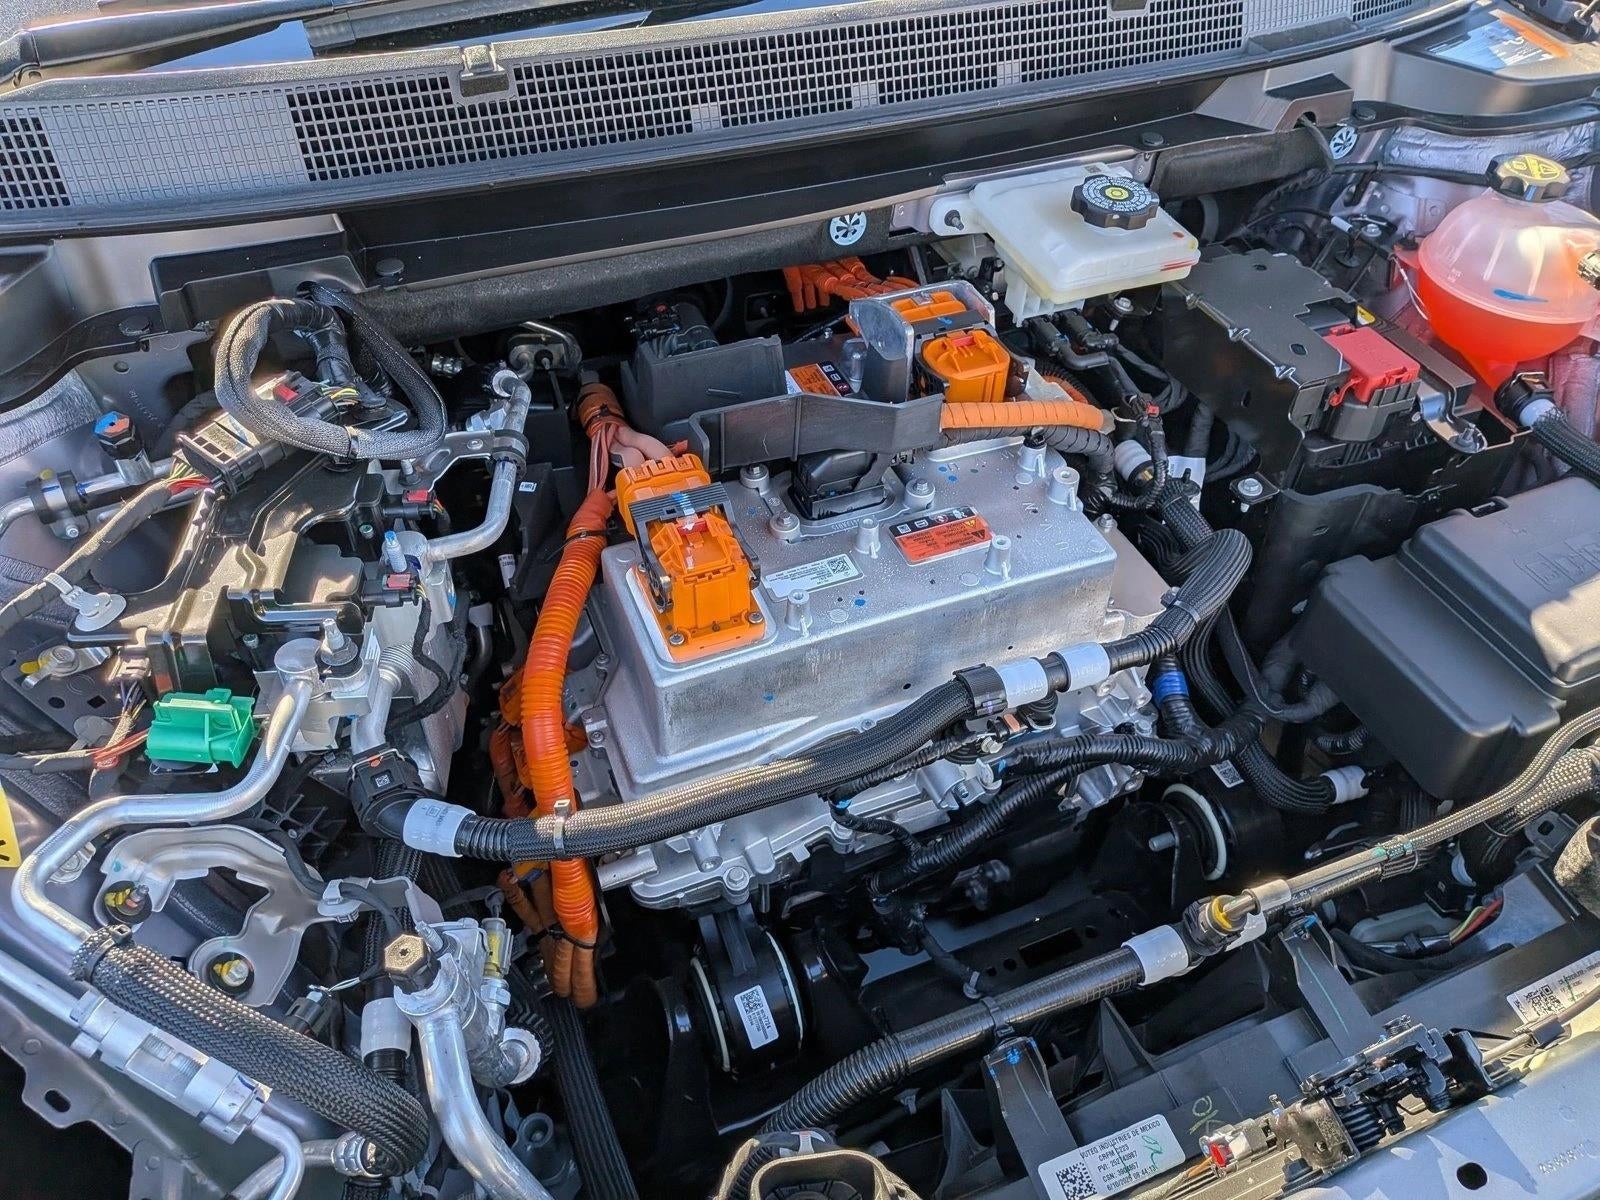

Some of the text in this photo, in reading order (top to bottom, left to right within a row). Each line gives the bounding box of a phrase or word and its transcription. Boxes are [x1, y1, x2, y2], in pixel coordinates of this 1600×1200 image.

[1099, 1134, 1131, 1151] INDUSTRIES
[1131, 1129, 1140, 1137] DE
[1139, 1120, 1161, 1134] MEXICO
[1097, 1162, 1111, 1173] PVI:
[1102, 1172, 1117, 1183] CSN:
